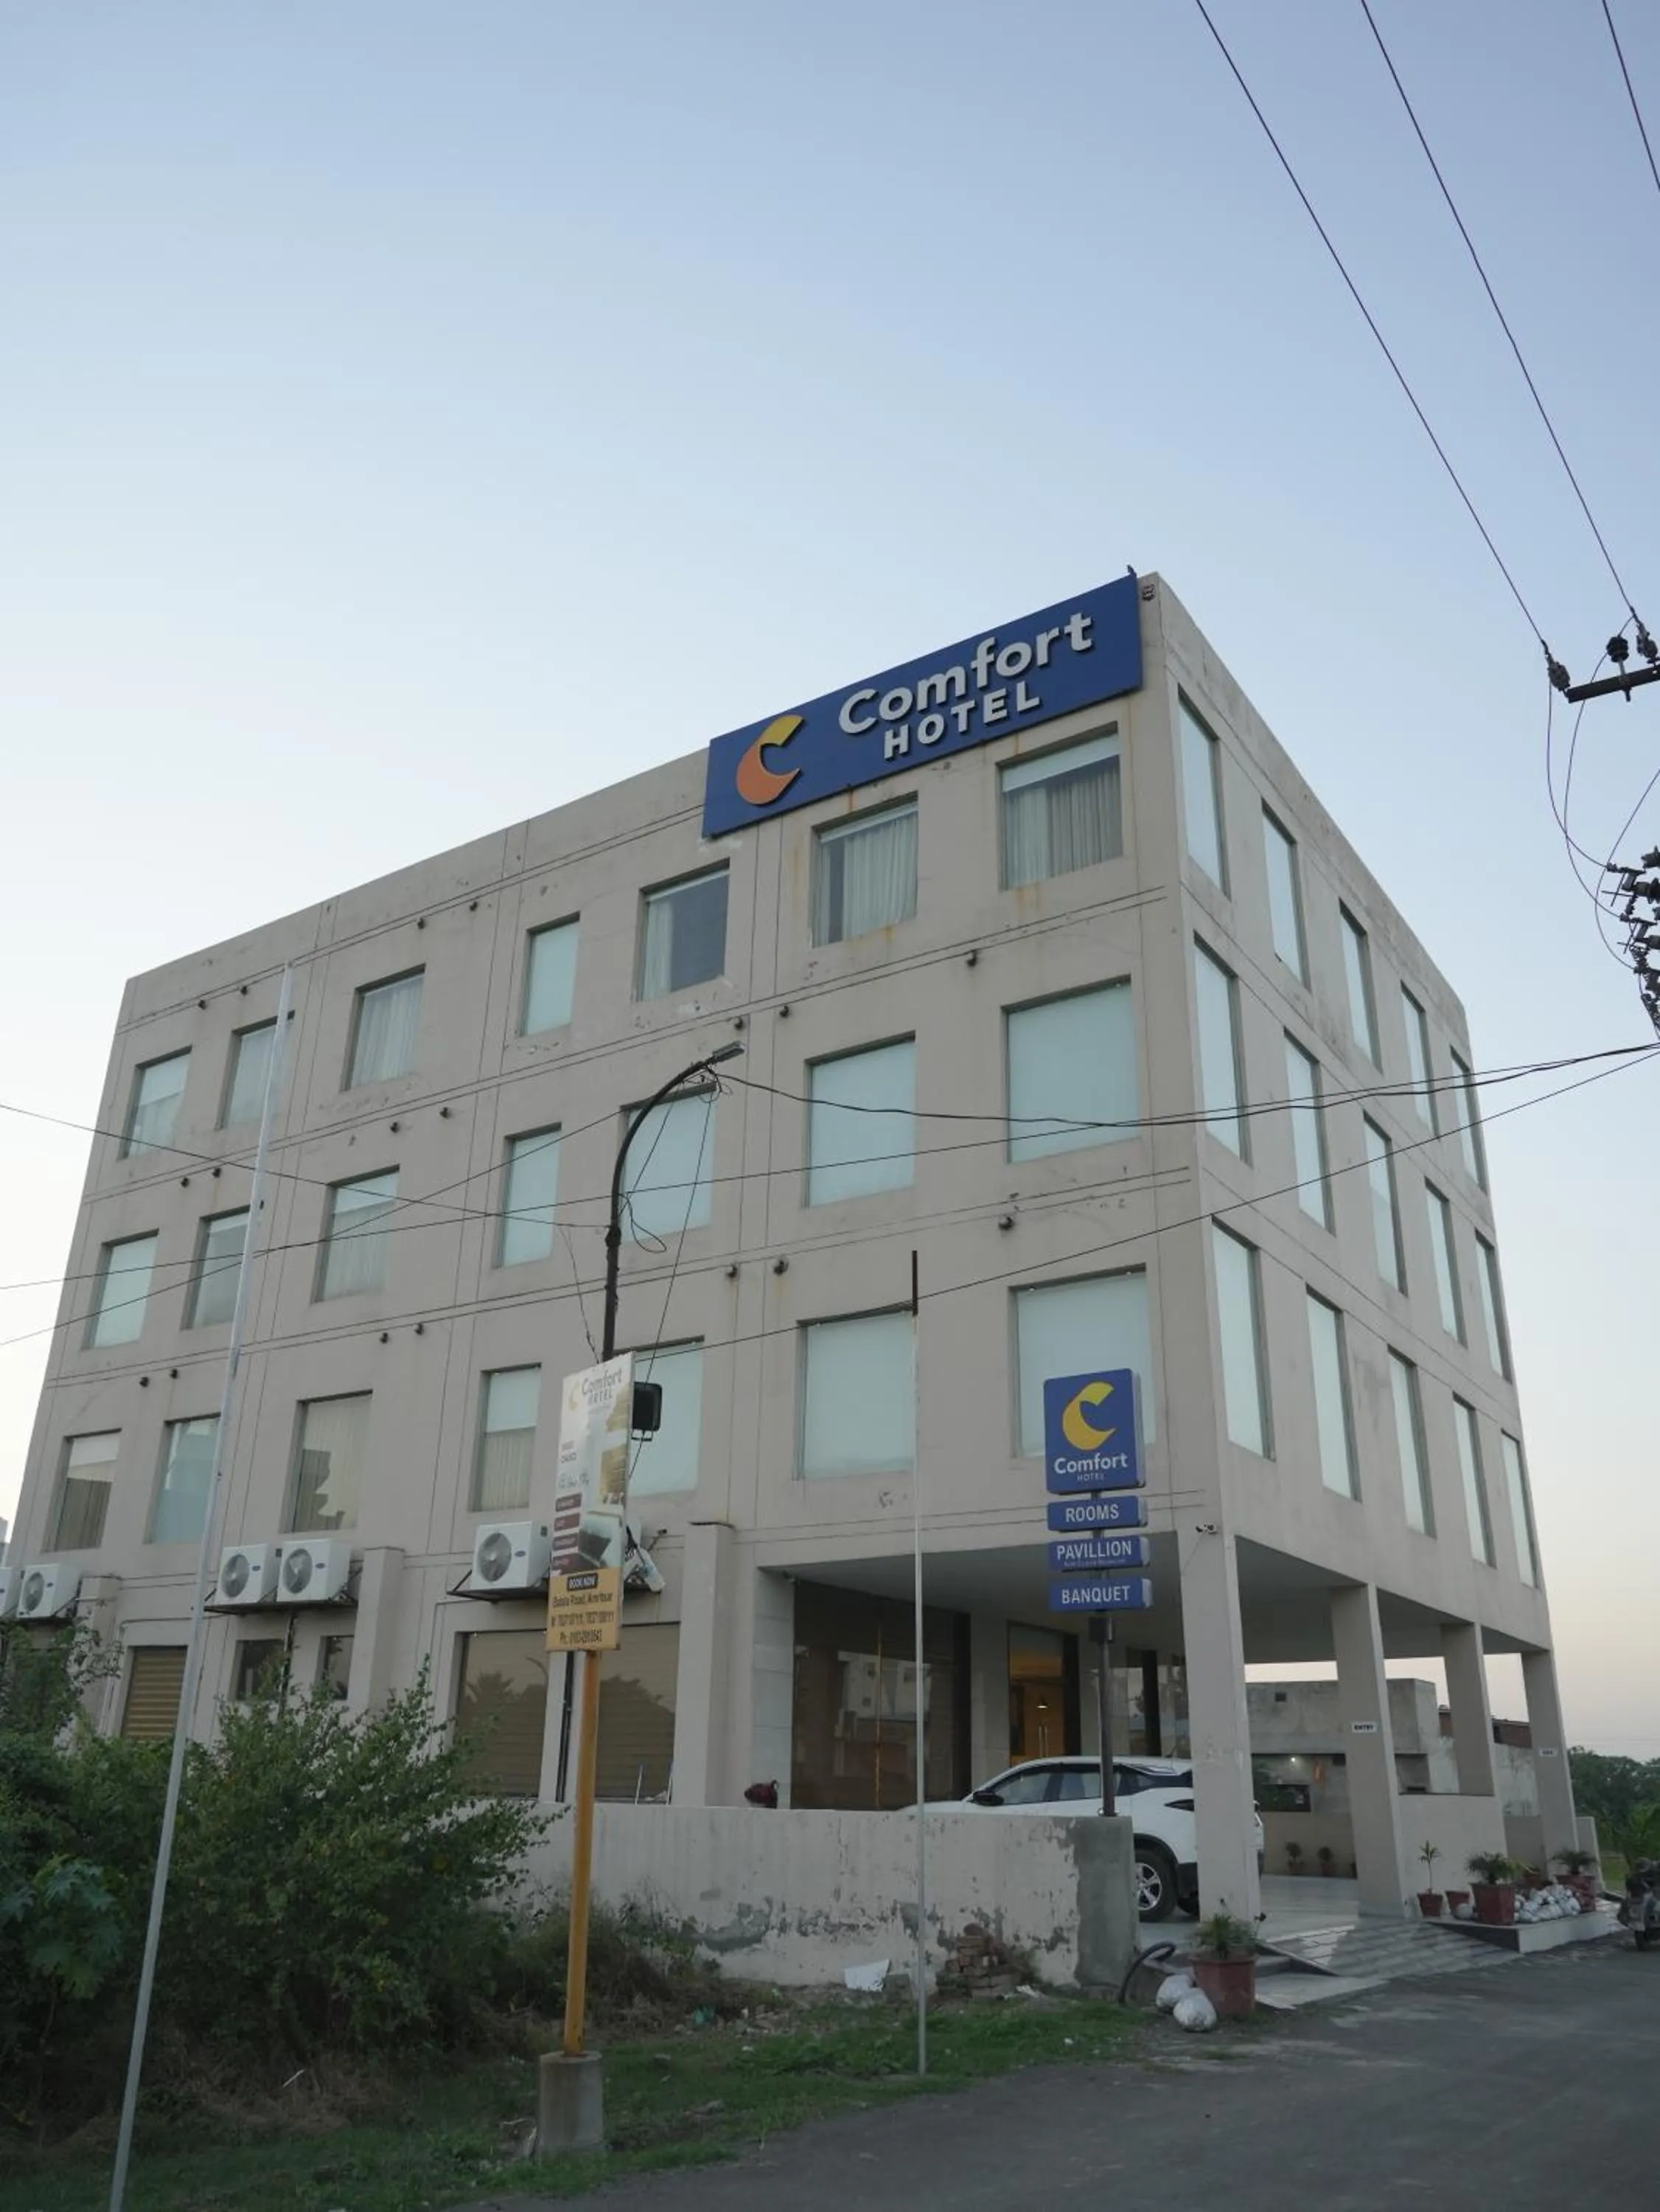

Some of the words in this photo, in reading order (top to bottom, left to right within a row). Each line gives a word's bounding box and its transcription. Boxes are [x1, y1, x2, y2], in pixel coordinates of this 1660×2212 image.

[839, 613, 1092, 734] Comfort
[884, 681, 1041, 762] HOTEL
[582, 1368, 622, 1395] Comfort
[1054, 1453, 1129, 1475] Comfort
[1077, 1473, 1105, 1481] HOTEL
[1065, 1503, 1120, 1523] ROOMS
[1056, 1540, 1132, 1561] PAVILLION
[1061, 1585, 1131, 1604] BANQUET
